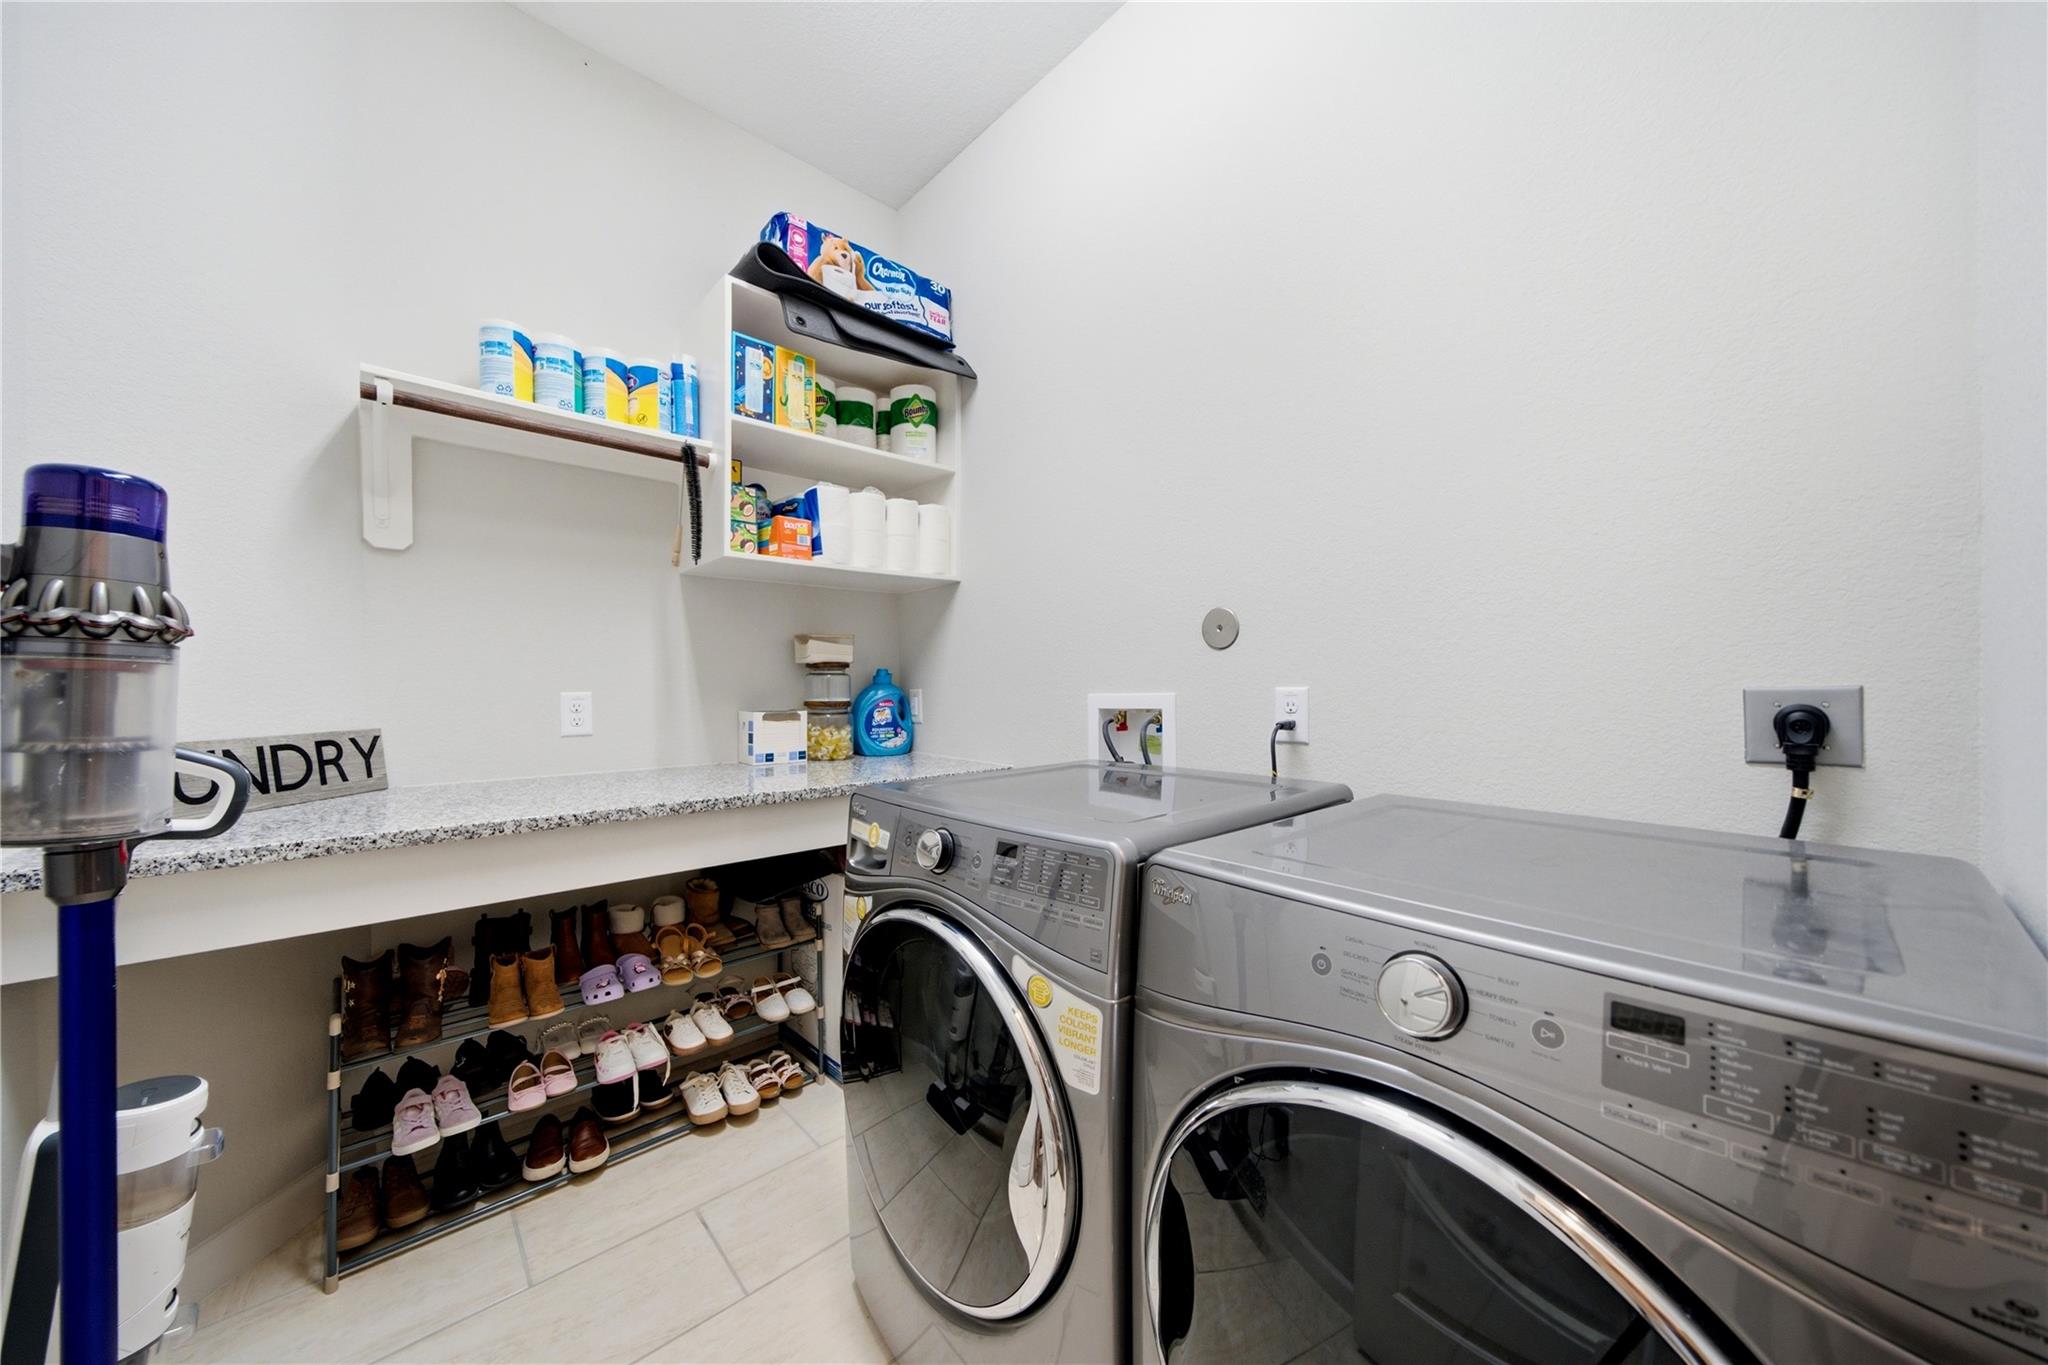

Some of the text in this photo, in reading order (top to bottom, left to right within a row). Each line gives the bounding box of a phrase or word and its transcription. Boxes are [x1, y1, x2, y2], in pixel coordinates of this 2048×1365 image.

[872, 262, 906, 282] Charmin
[929, 281, 946, 294] 30
[904, 405, 929, 418] Bounty
[174, 735, 381, 806] UNDRY
[1152, 880, 1193, 905] Whirlpool
[1059, 1015, 1097, 1034] COLORS
[1067, 1007, 1098, 1023] KEEPS
[1057, 1025, 1097, 1044] VIBRANT
[1484, 1033, 1516, 1049] SANITIZE
[1058, 1037, 1097, 1056] LONGER
[1623, 1055, 1650, 1069] Check
